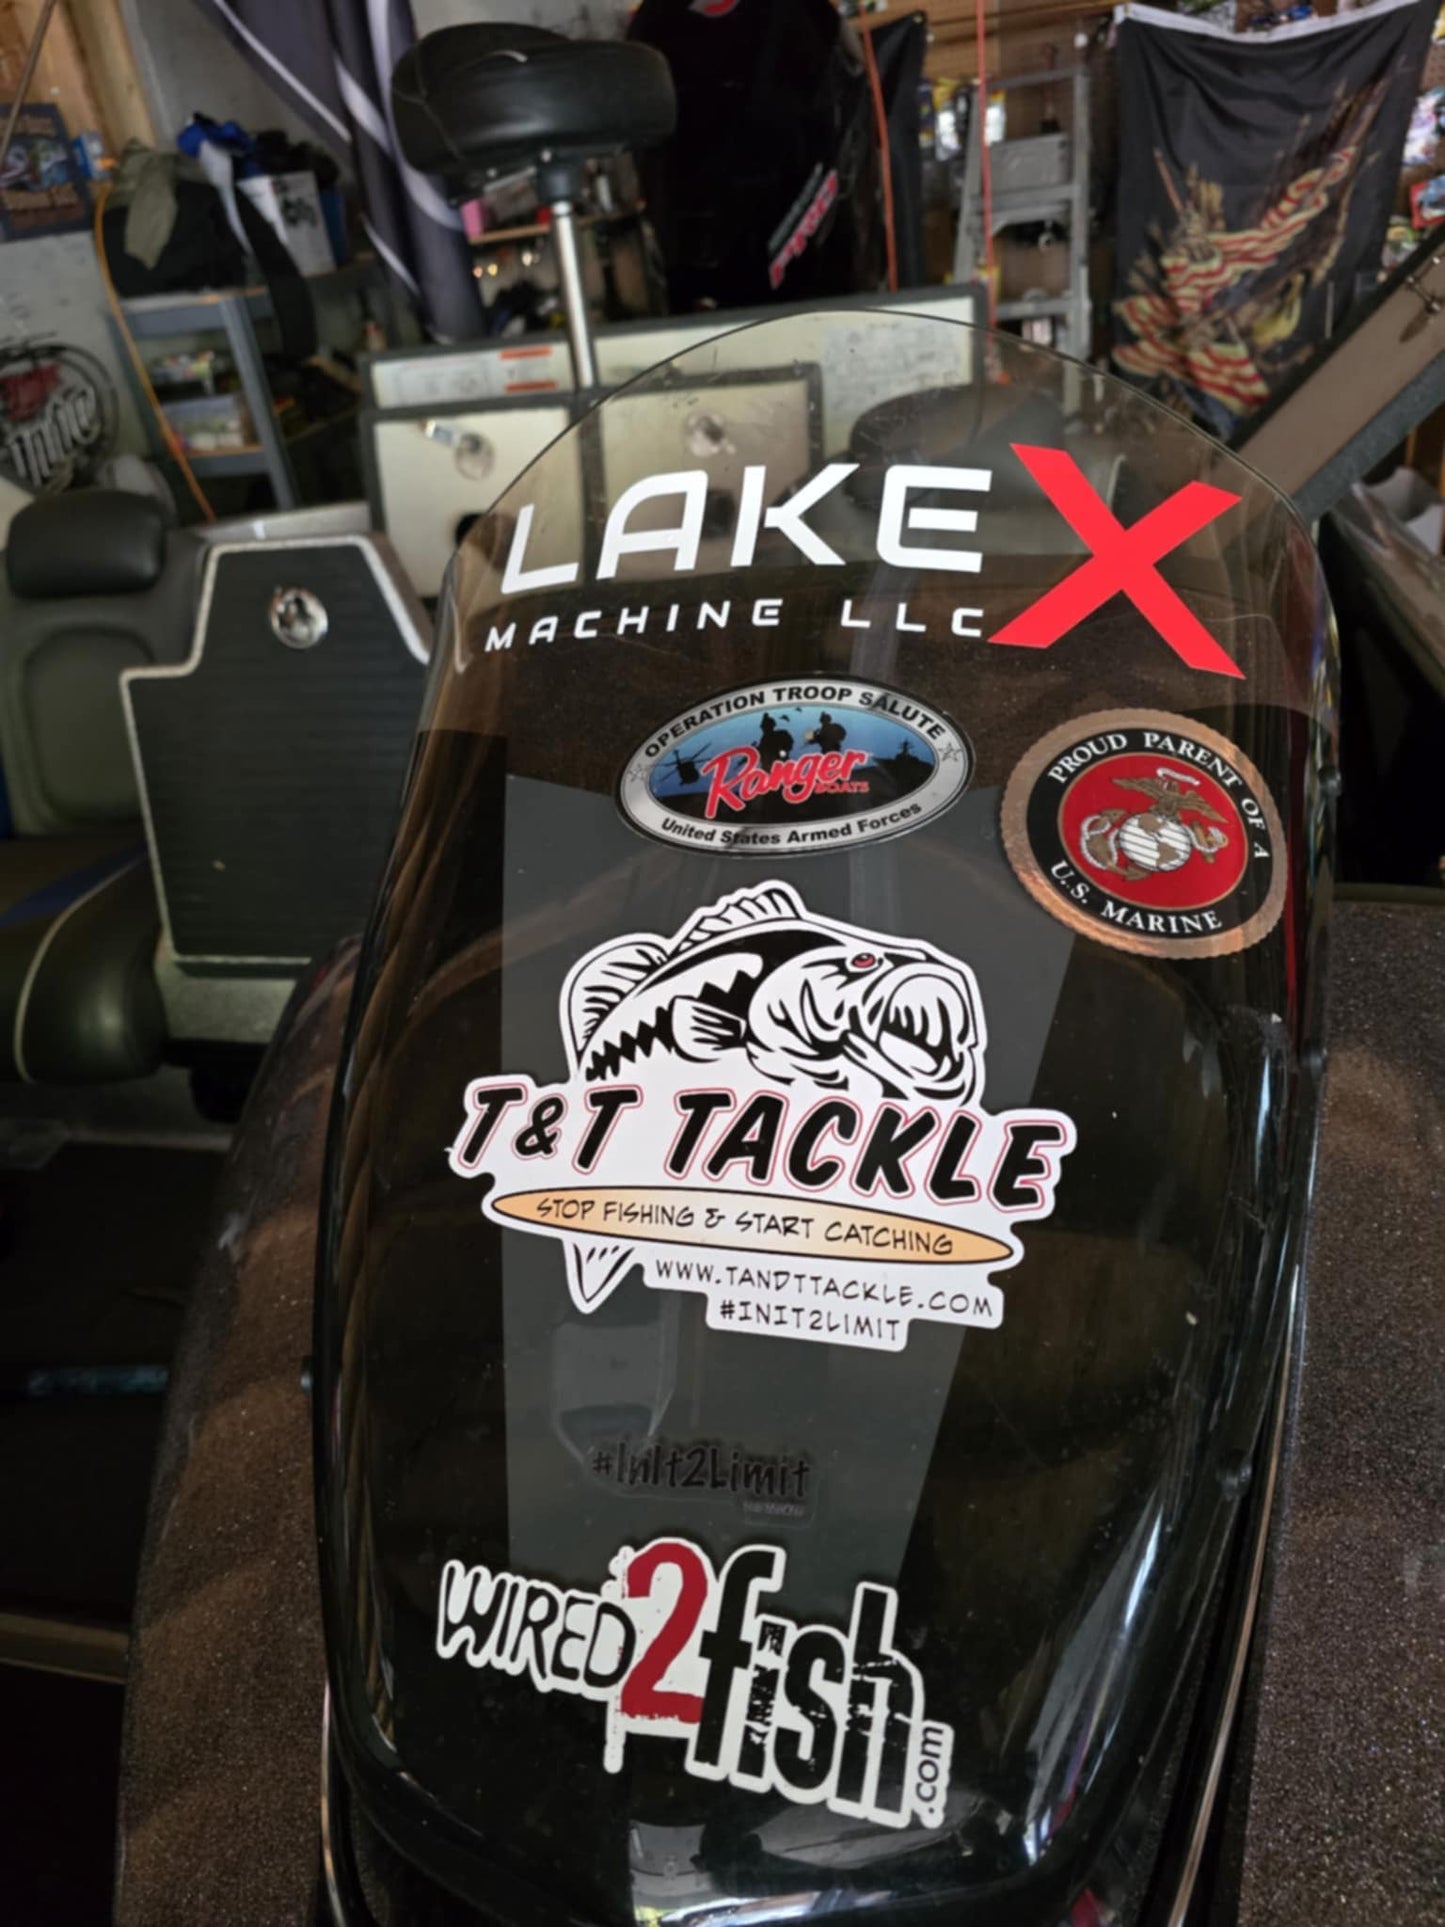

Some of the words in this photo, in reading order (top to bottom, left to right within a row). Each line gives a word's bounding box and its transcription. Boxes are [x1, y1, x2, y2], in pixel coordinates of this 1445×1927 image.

[500, 462, 993, 595] LAKE
[987, 442, 1246, 680] X
[484, 599, 783, 652] MACHINE
[841, 599, 984, 638] LLC
[644, 690, 766, 758] OPERATION
[772, 685, 854, 702] TROOP
[858, 690, 947, 741] SALUTE
[702, 745, 870, 820] Ranger
[814, 780, 870, 794] BOATS
[1047, 732, 1128, 784] PROUD
[1143, 731, 1244, 788] PARENT
[1240, 798, 1266, 831] OF
[1253, 842, 1270, 859] A
[661, 817, 715, 844] United
[720, 830, 781, 845] States
[787, 823, 853, 844] Armed
[858, 802, 923, 834] Forces
[1100, 899, 1223, 934] MARINE
[456, 1085, 643, 1174] T&T
[665, 1089, 1068, 1213] TACKLE
[536, 1197, 595, 1222] STOP
[602, 1200, 695, 1230] FISHING
[704, 1210, 726, 1229] &
[734, 1210, 815, 1240] START
[824, 1221, 955, 1257] CATCHING
[655, 1259, 994, 1318] WWW.TANDTTACKLE.COM
[720, 1301, 902, 1342] #INIT2LIMIT
